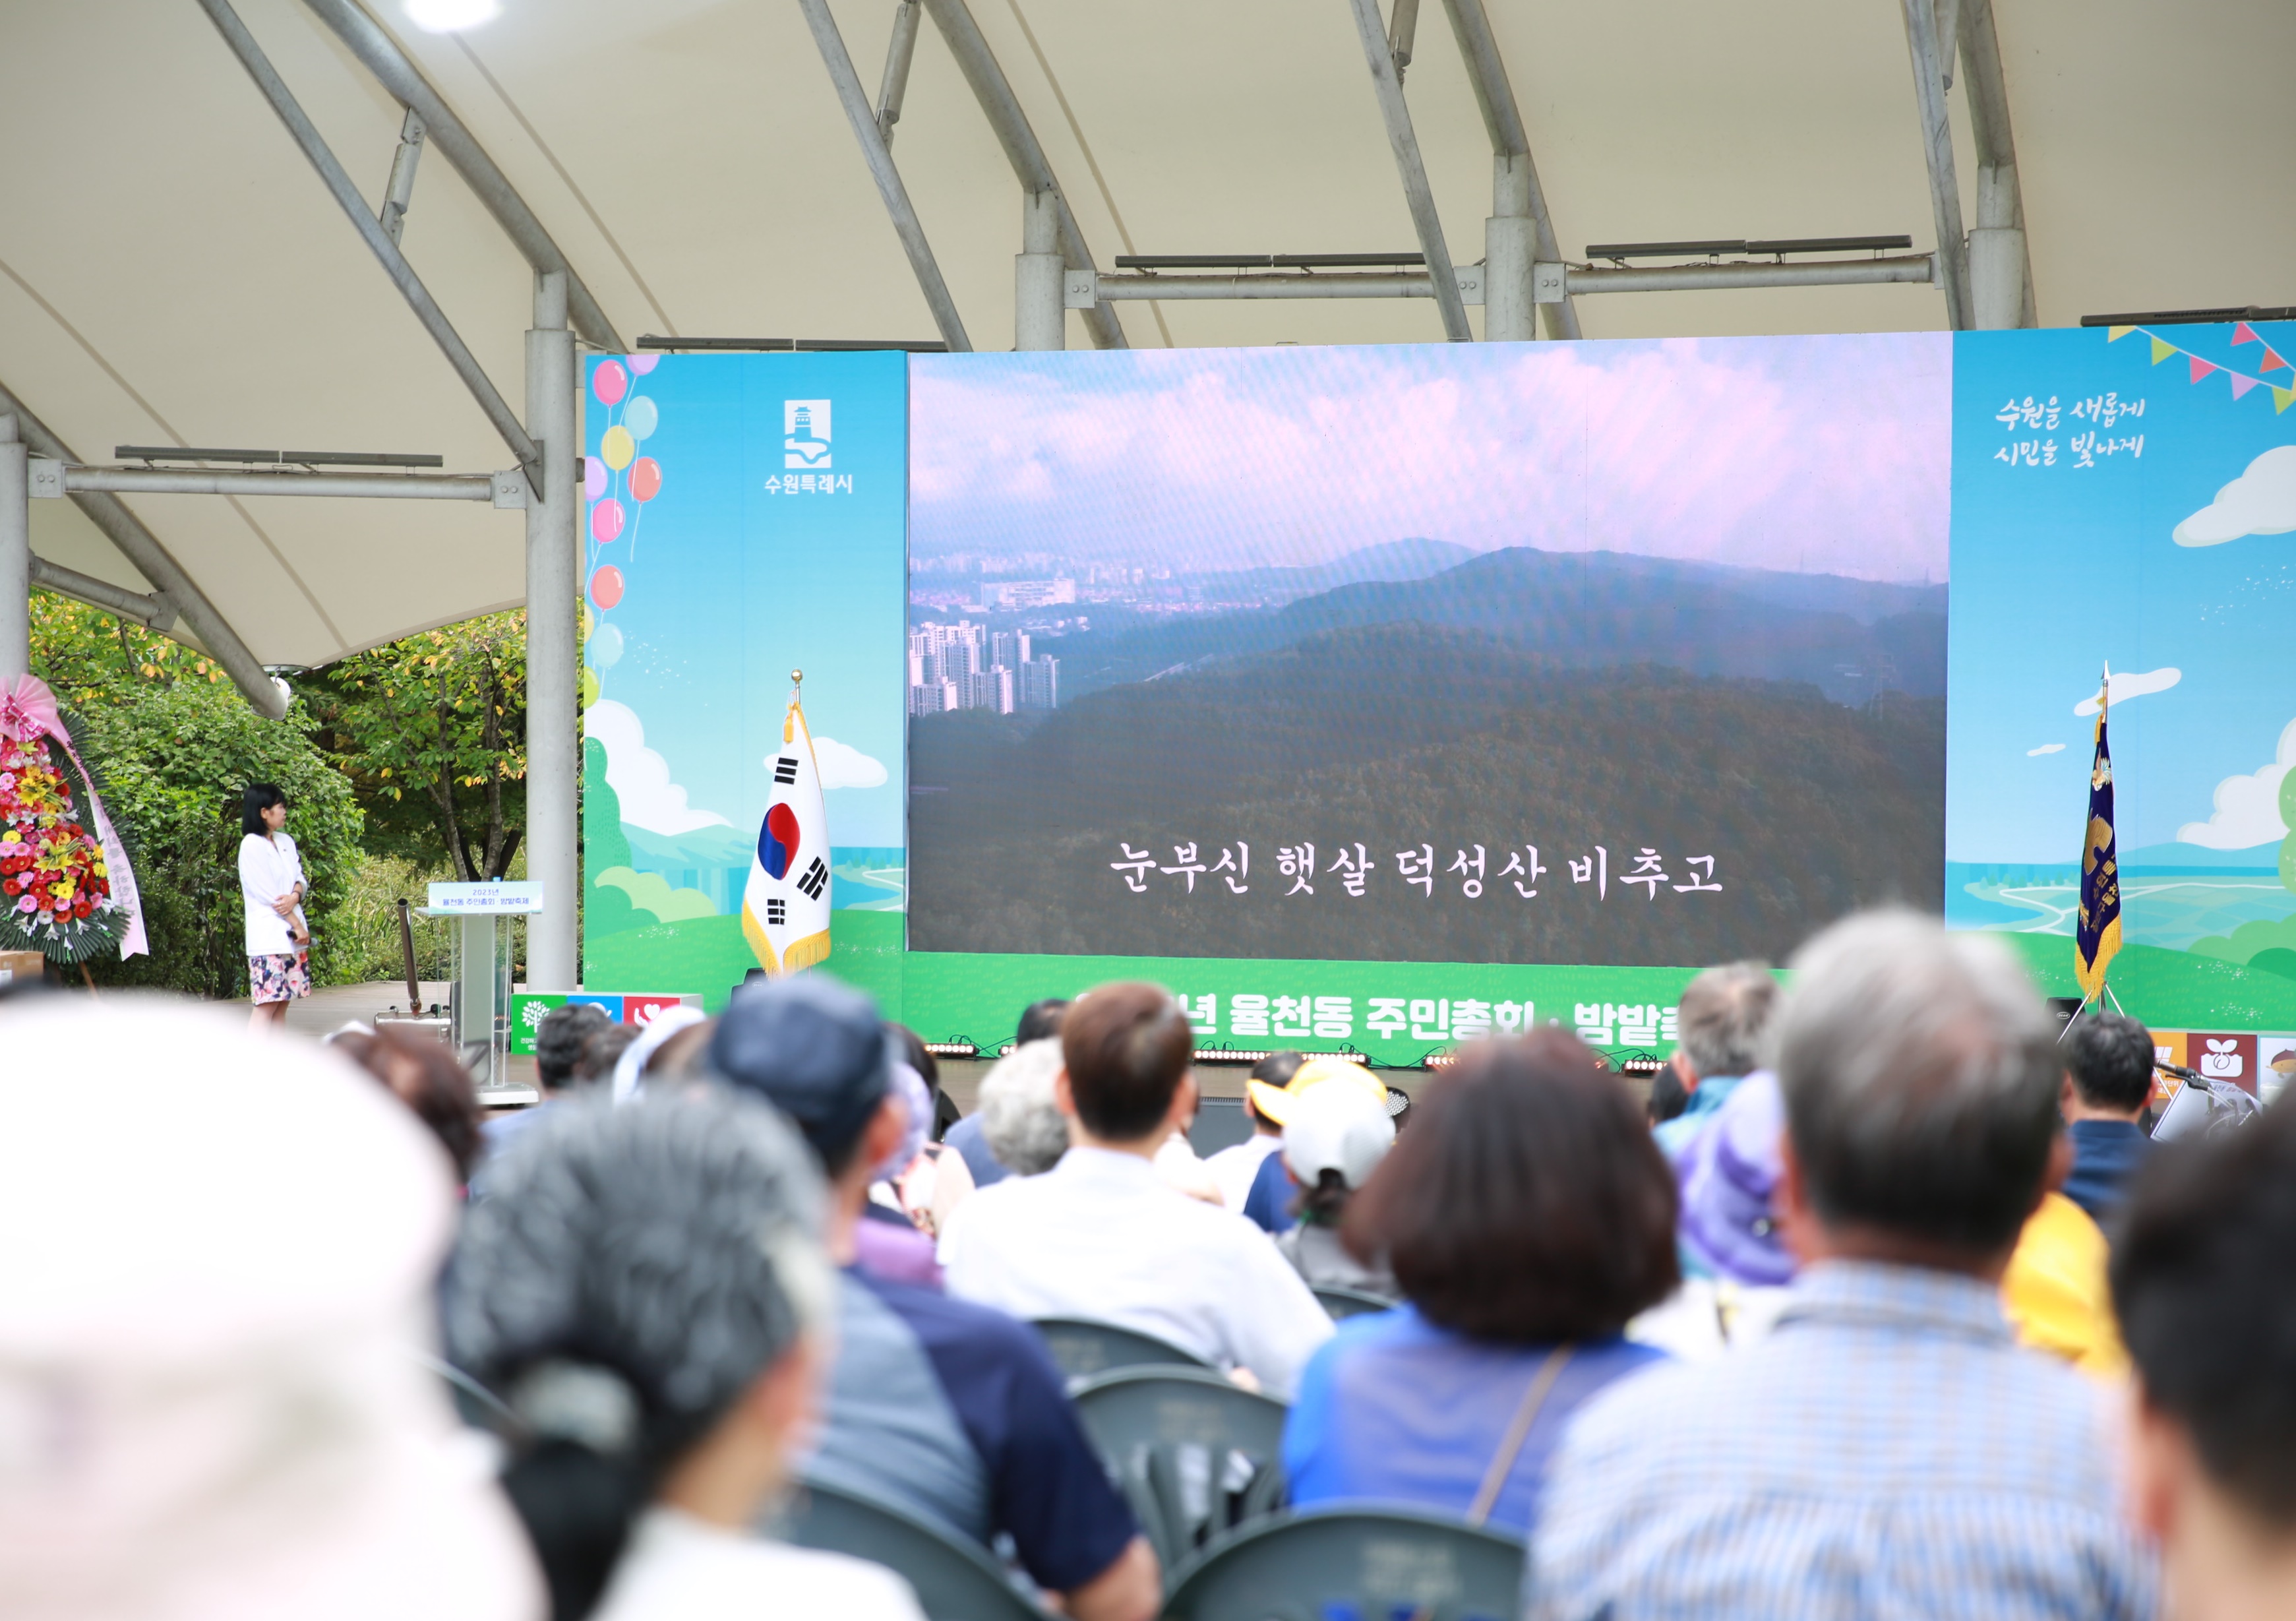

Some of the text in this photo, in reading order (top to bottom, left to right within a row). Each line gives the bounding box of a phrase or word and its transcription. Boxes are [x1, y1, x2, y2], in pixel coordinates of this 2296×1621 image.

[1995, 392, 2145, 431] 수원을 새롭게
[1994, 431, 2144, 468] 시민을 빛나게
[764, 474, 853, 494] 수원특례시
[1110, 841, 1723, 902] 눈부신 햇살 덕성산 비추고
[1230, 993, 1353, 1038] 율천동
[1366, 998, 1535, 1041] 주민총회
